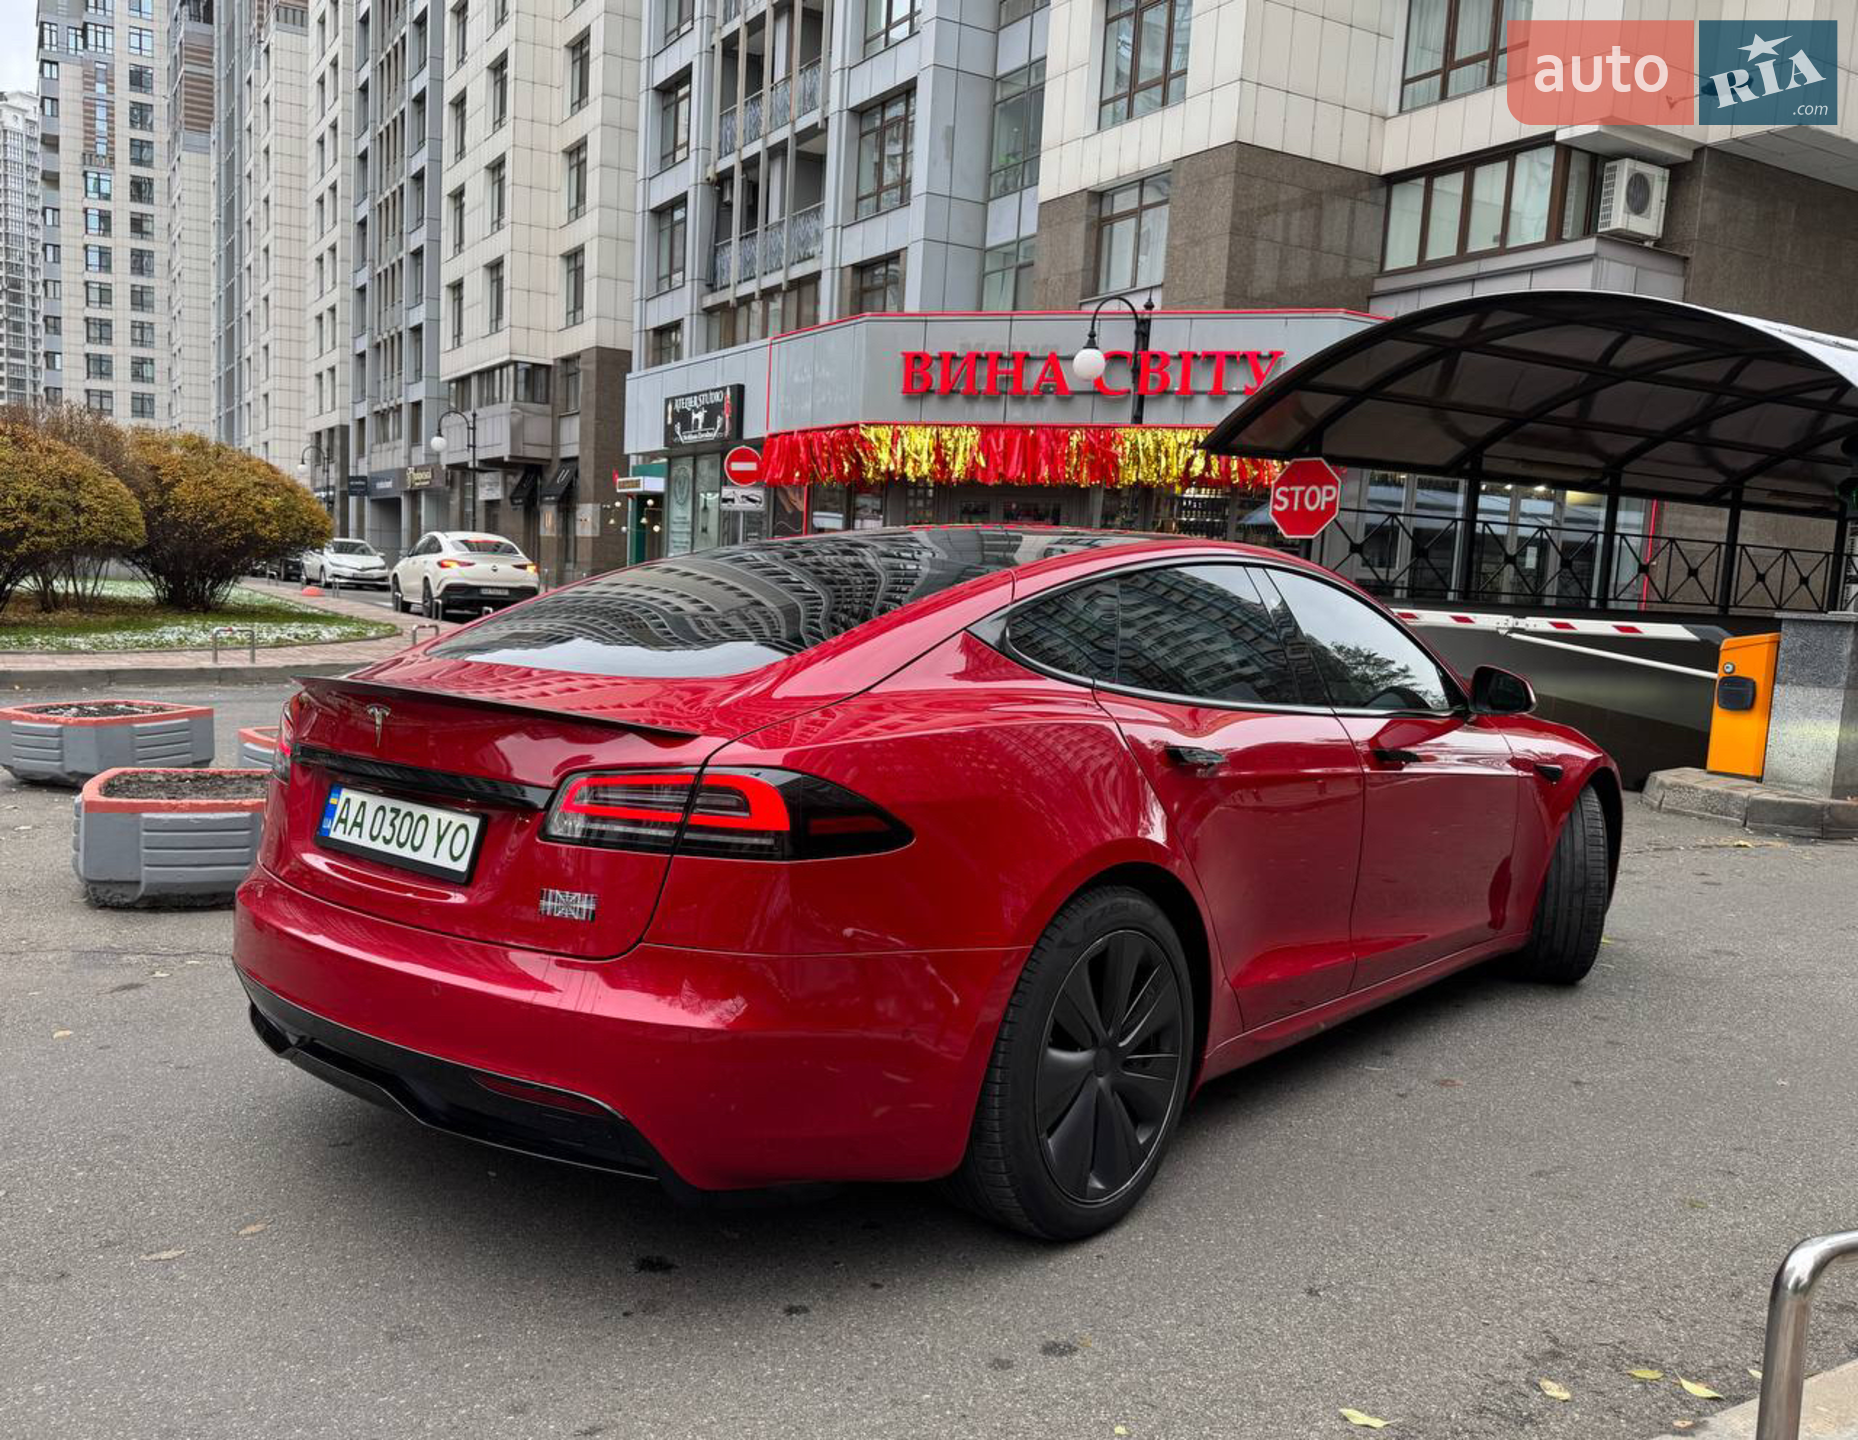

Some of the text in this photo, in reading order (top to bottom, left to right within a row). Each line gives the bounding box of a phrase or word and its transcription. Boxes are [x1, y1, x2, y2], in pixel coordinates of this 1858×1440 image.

[901, 350, 1285, 397] ВИНА СВІТУ
[1273, 484, 1337, 513] STOP
[333, 797, 470, 862] AA 0300 YO
